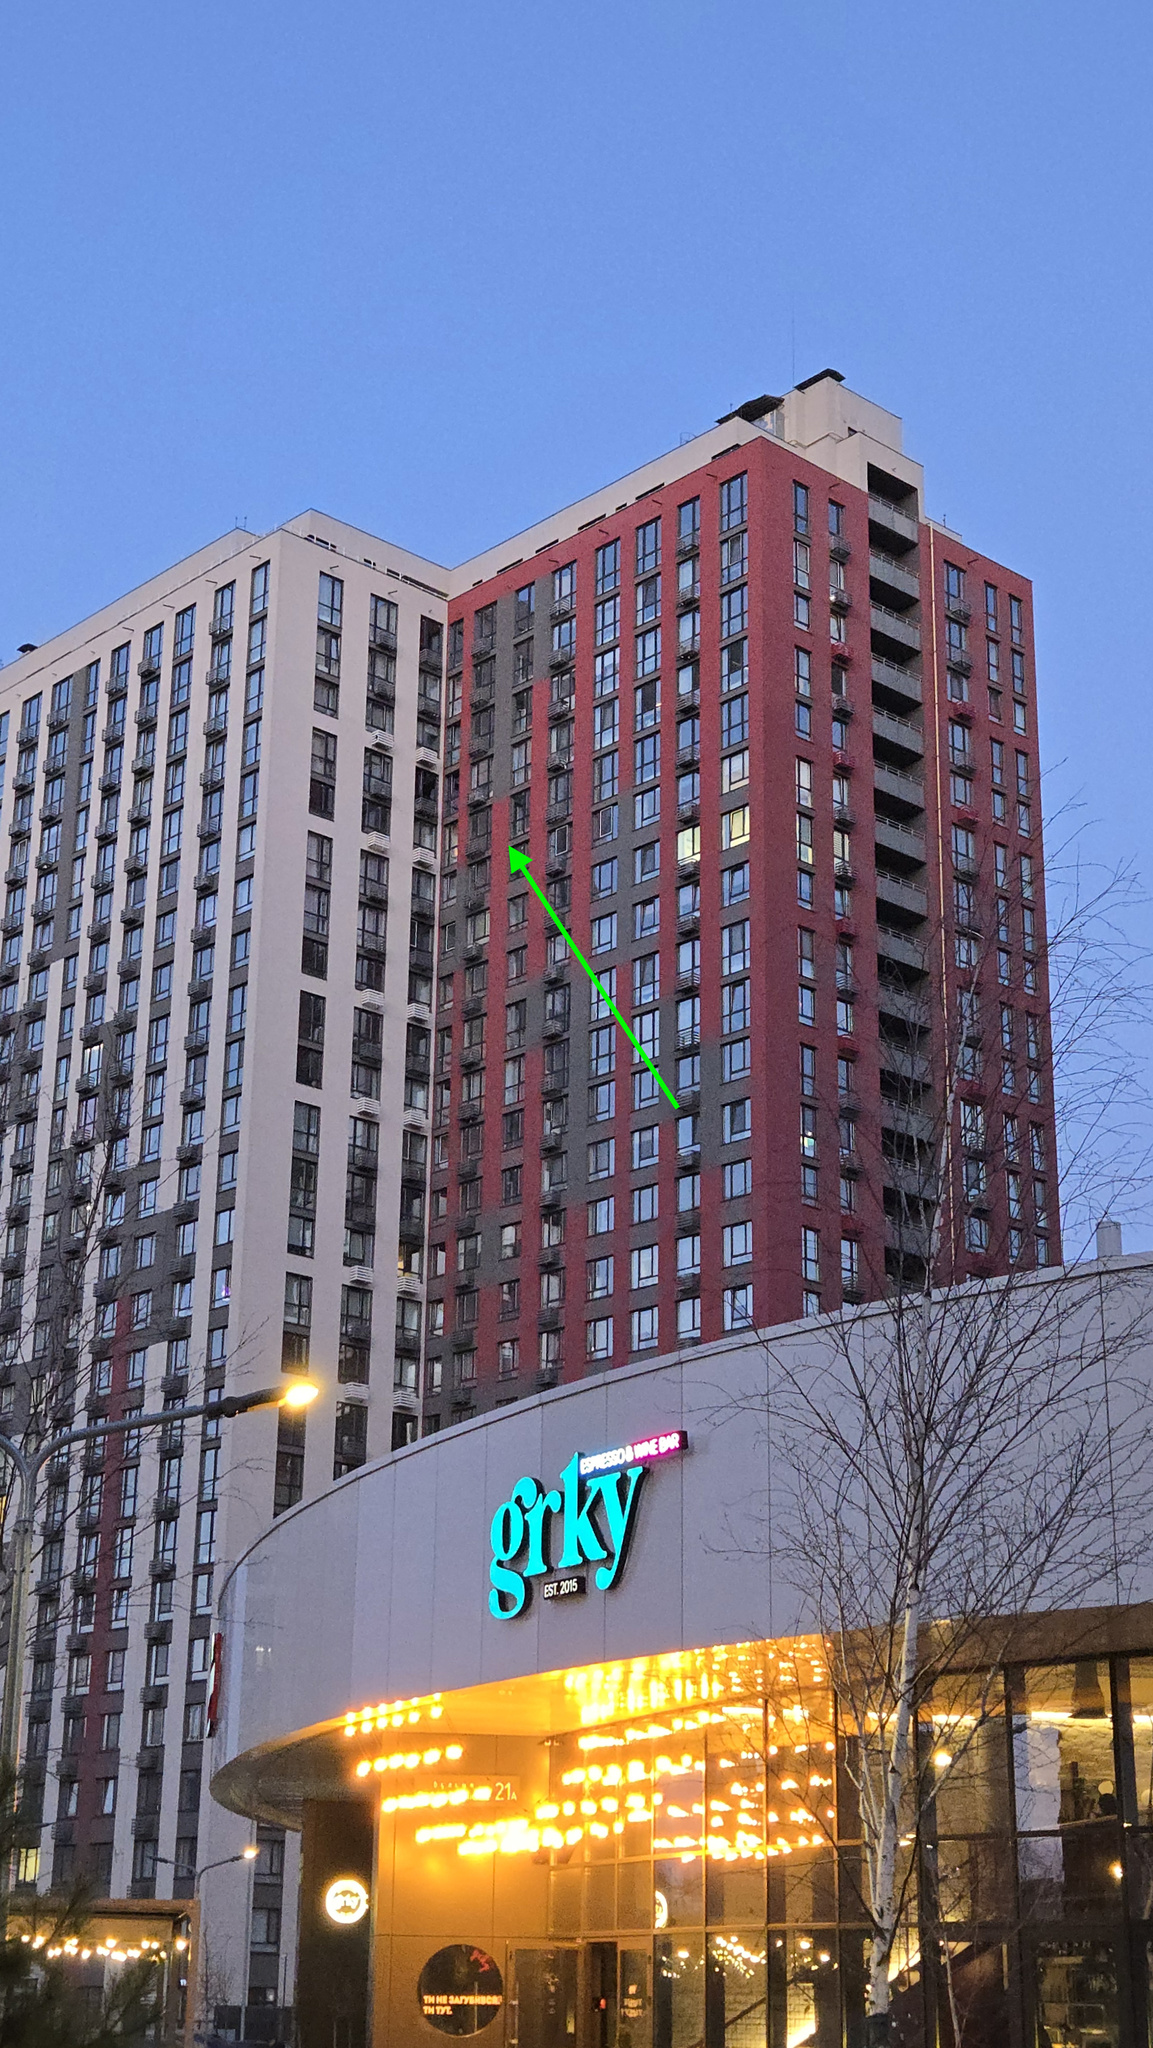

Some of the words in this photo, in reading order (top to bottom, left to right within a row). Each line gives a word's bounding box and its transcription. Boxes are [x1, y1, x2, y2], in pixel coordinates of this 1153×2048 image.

[580, 1448, 625, 1475] ESPRESSO
[634, 1438, 658, 1459] WINE
[659, 1433, 680, 1453] BAR
[488, 1451, 645, 1620] grky
[544, 1583, 559, 1598] EST.
[560, 1578, 578, 1595] 2015
